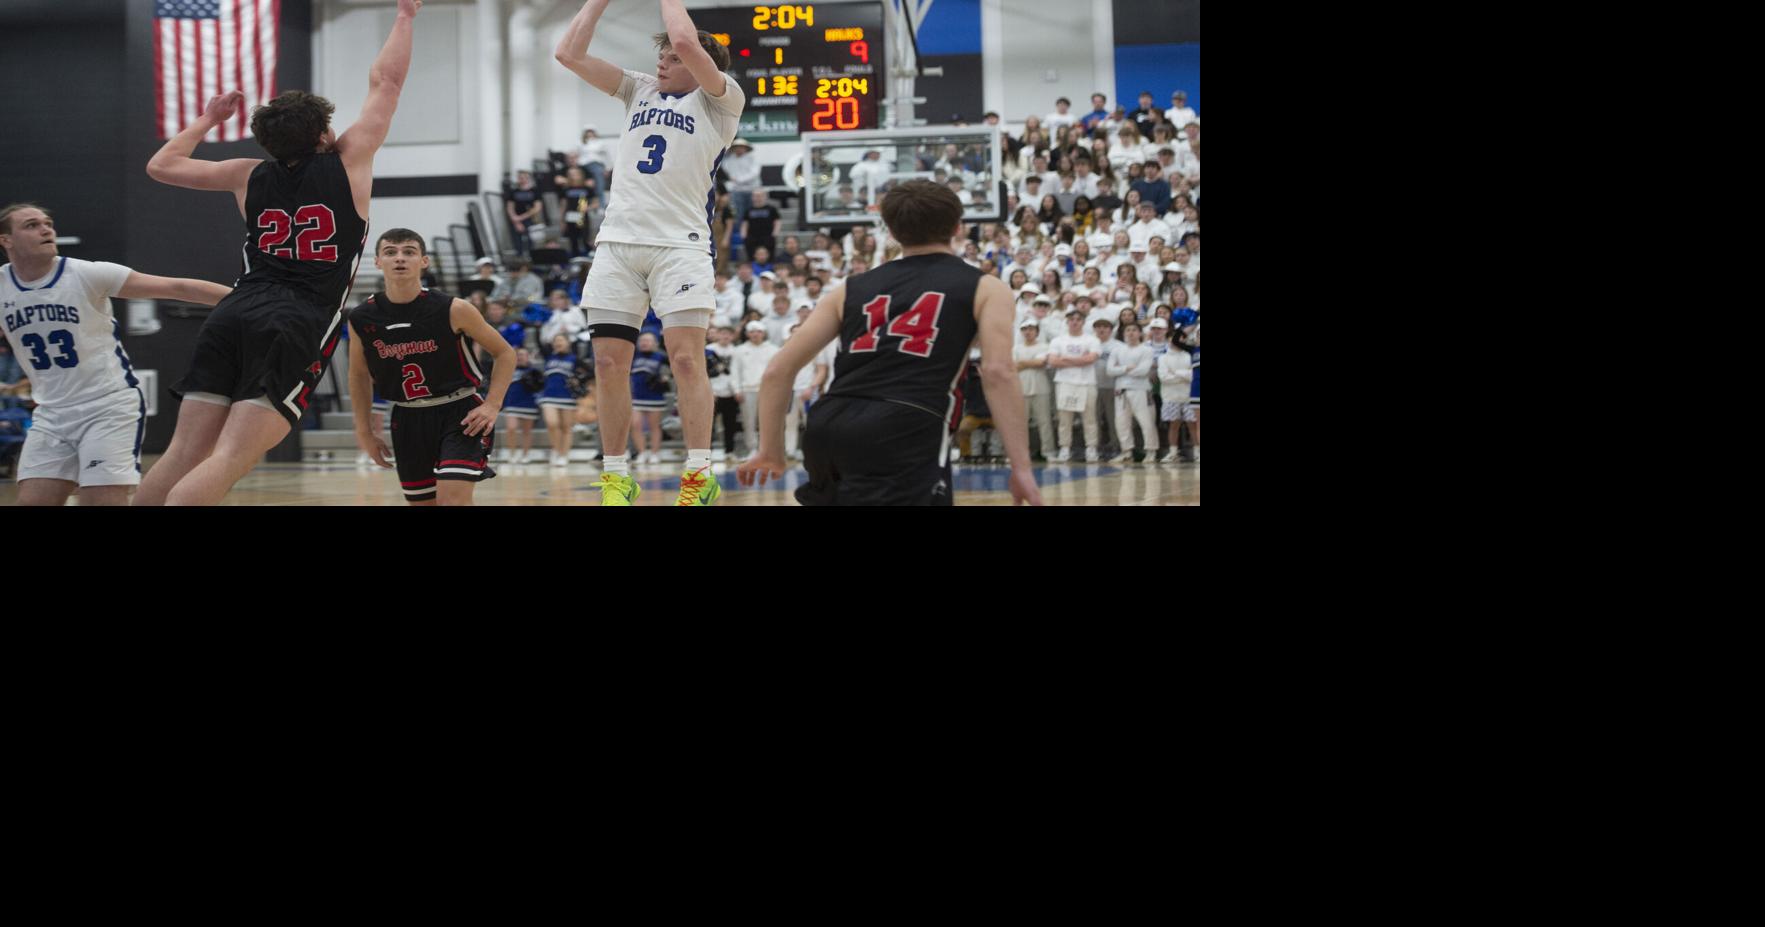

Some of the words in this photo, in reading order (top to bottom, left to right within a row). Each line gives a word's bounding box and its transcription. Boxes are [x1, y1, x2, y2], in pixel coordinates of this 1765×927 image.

[753, 5, 813, 30] 2:04
[775, 48, 783, 65] 1
[850, 40, 868, 63] 9
[816, 78, 867, 98] 2:04
[629, 107, 695, 135] RAPTORS
[812, 97, 860, 130] 20
[636, 134, 667, 174] 3
[257, 203, 338, 262] 22
[5, 304, 80, 332] RAPTORS
[849, 291, 946, 357] 14
[21, 329, 80, 370] 33
[373, 339, 438, 360] Bozeman
[402, 363, 432, 400] 2
